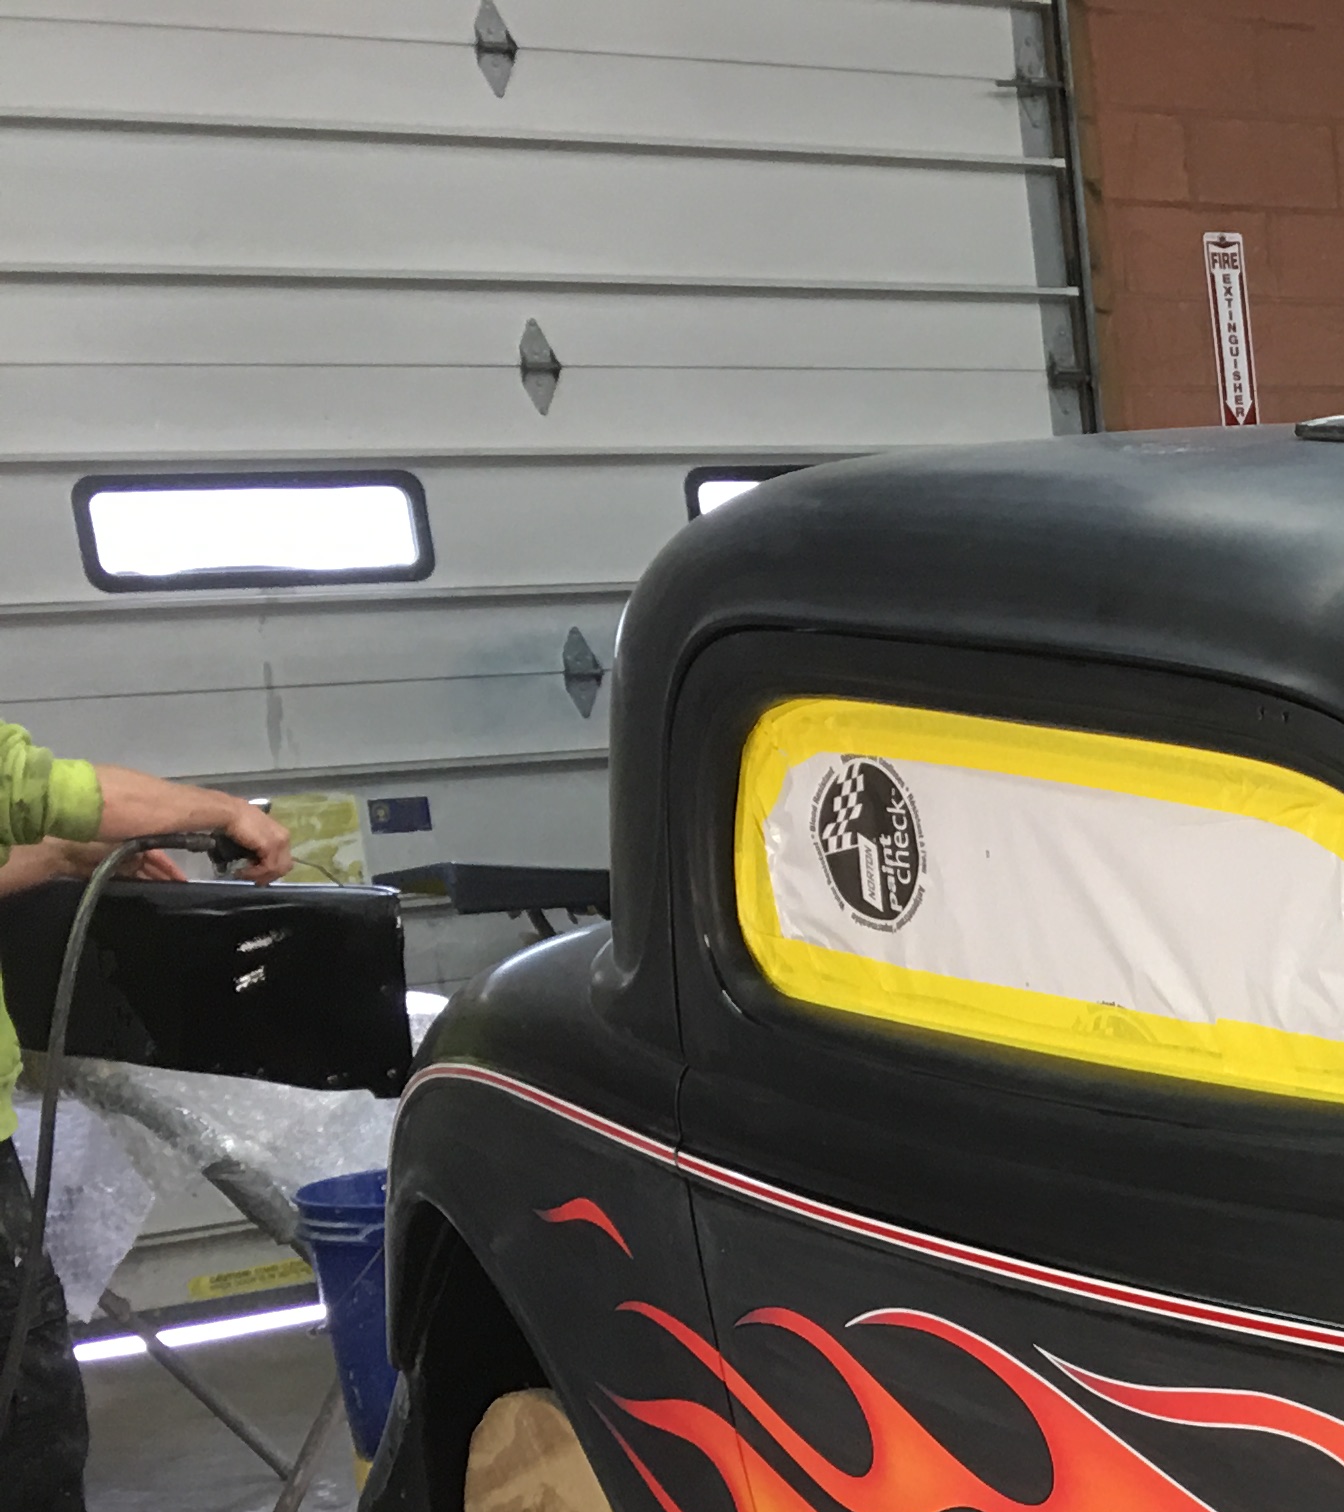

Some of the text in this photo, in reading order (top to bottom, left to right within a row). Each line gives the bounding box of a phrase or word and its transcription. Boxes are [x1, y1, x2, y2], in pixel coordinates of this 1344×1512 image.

[1211, 252, 1239, 270] FIRE
[1222, 273, 1245, 417] EXTINGUISHER
[864, 844, 877, 902] NORTON
[879, 833, 903, 912] paint
[886, 798, 912, 885] check
